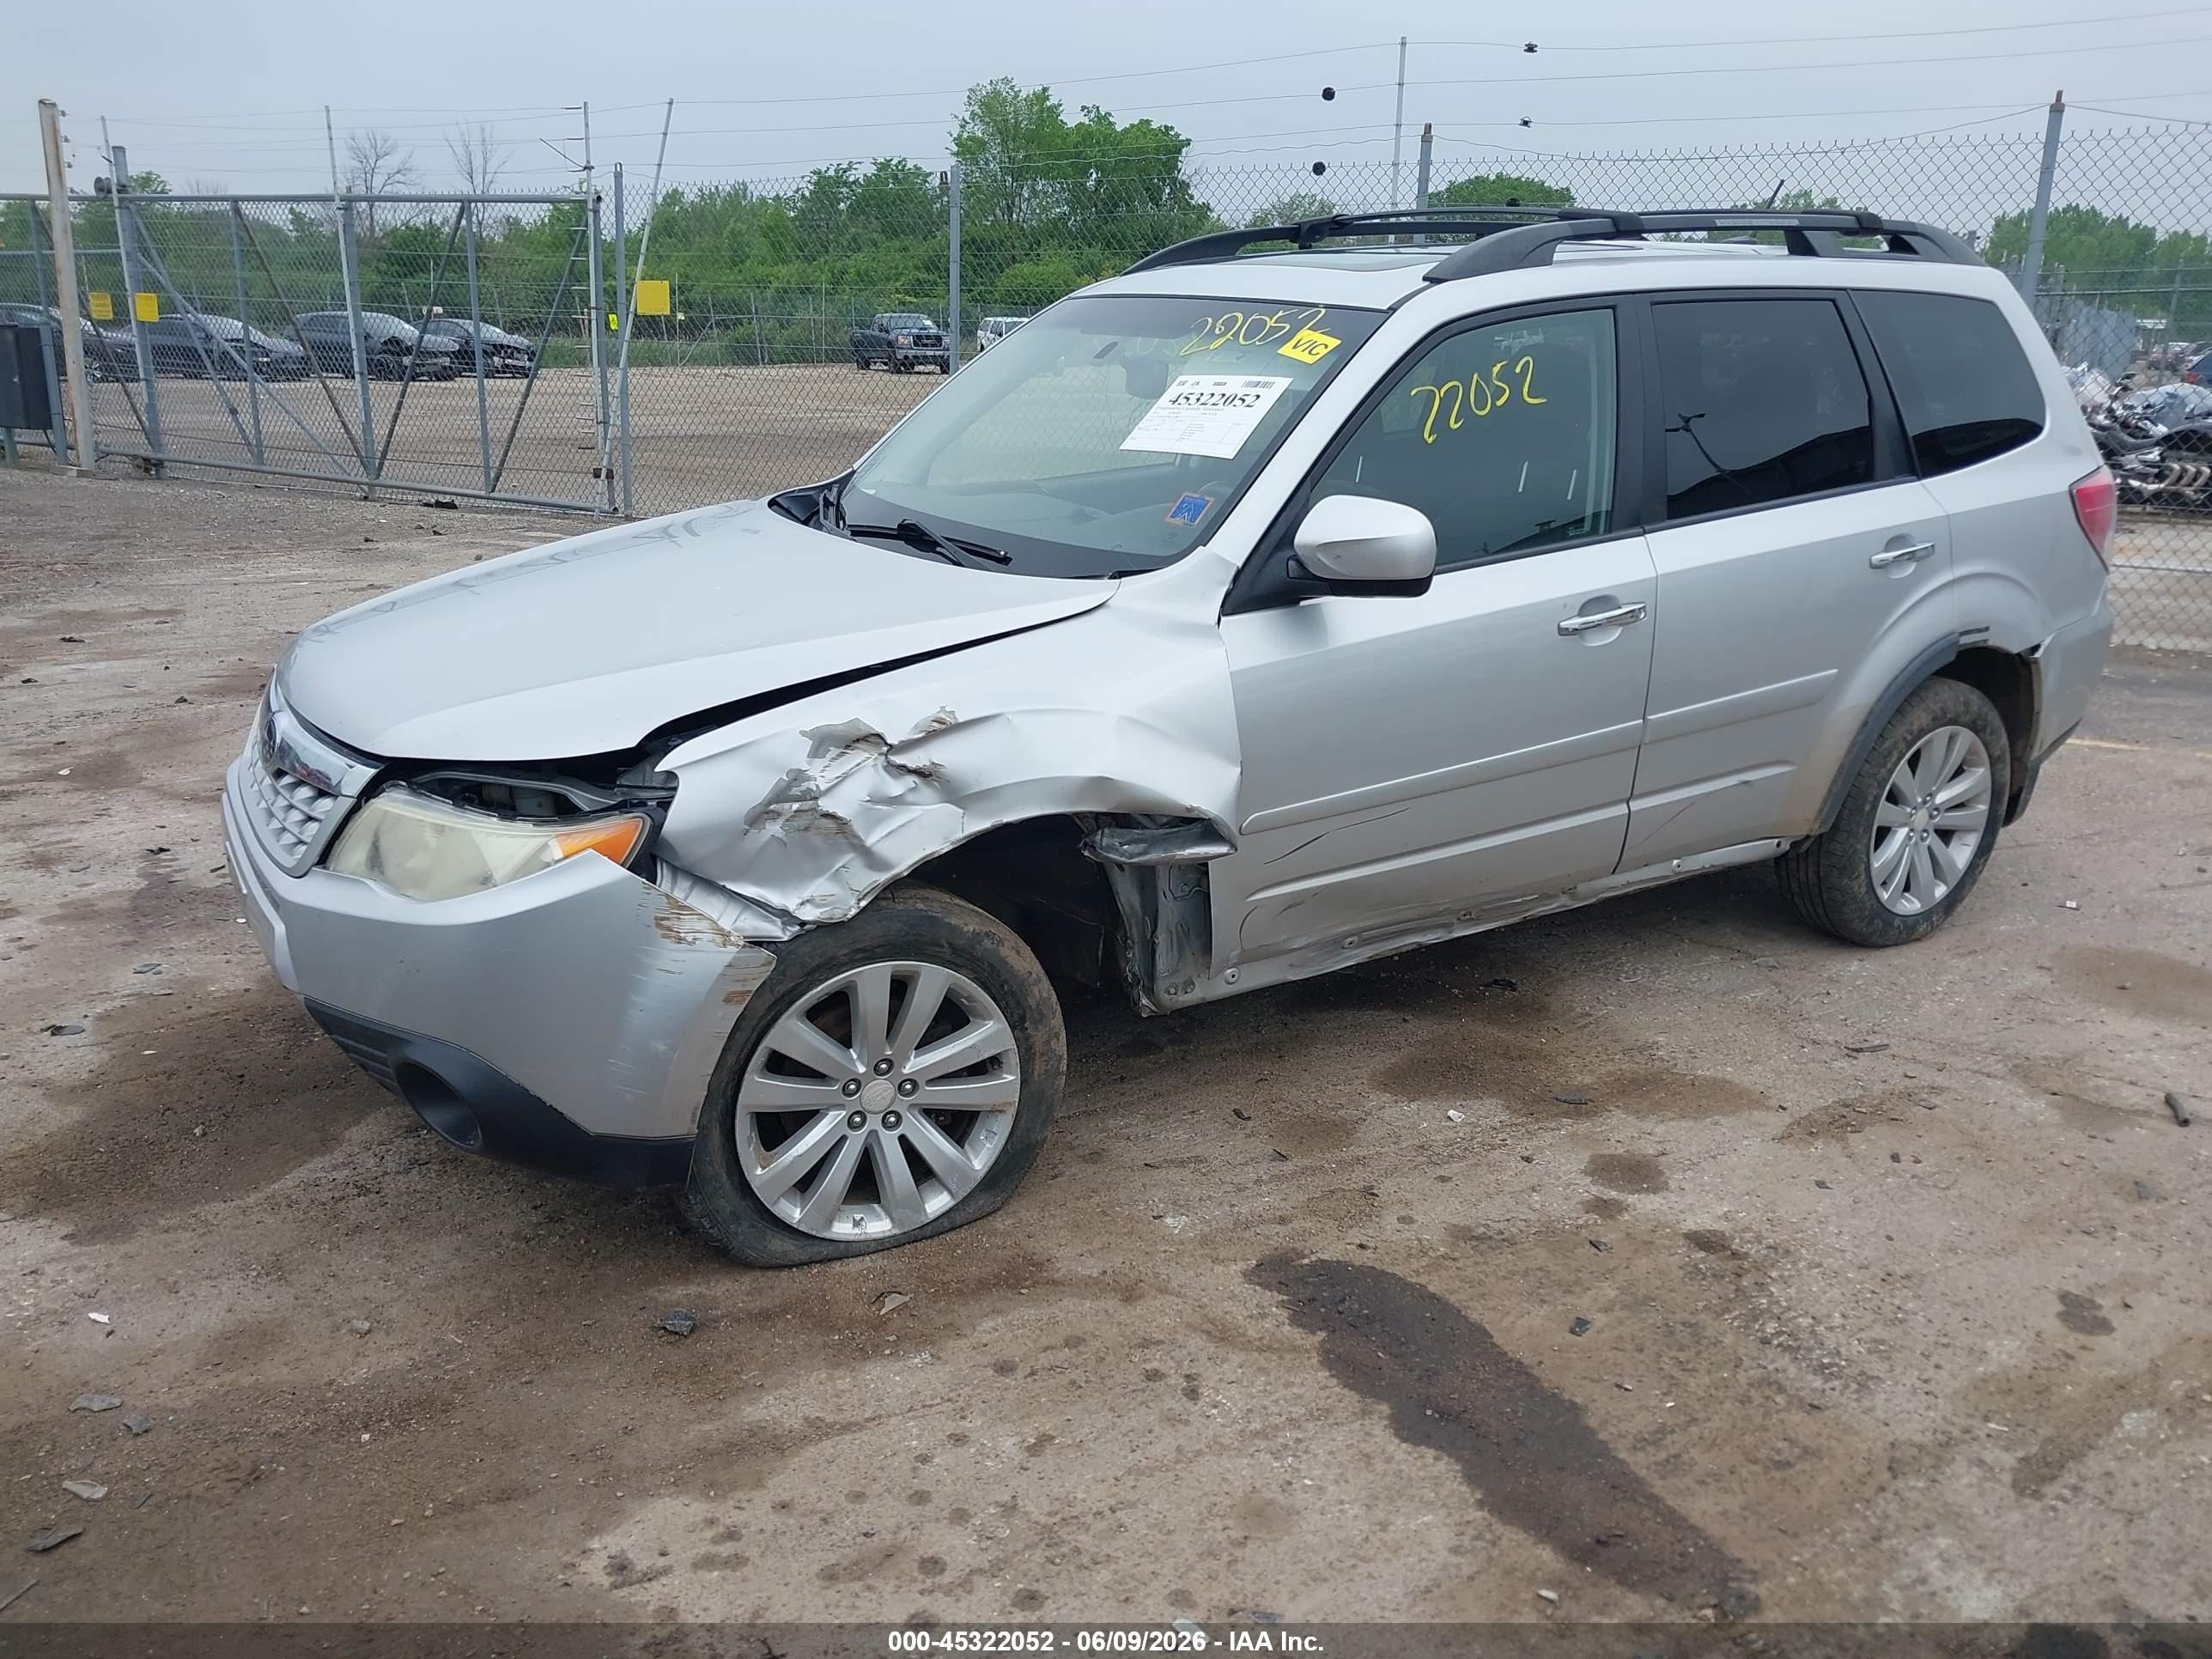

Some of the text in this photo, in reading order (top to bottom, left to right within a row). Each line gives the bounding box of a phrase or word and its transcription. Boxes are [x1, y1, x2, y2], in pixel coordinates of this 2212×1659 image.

[1180, 307, 1331, 357] 22052
[1291, 337, 1329, 357] VIC
[1168, 392, 1261, 409] 45322052
[1410, 355, 1548, 445] 22052
